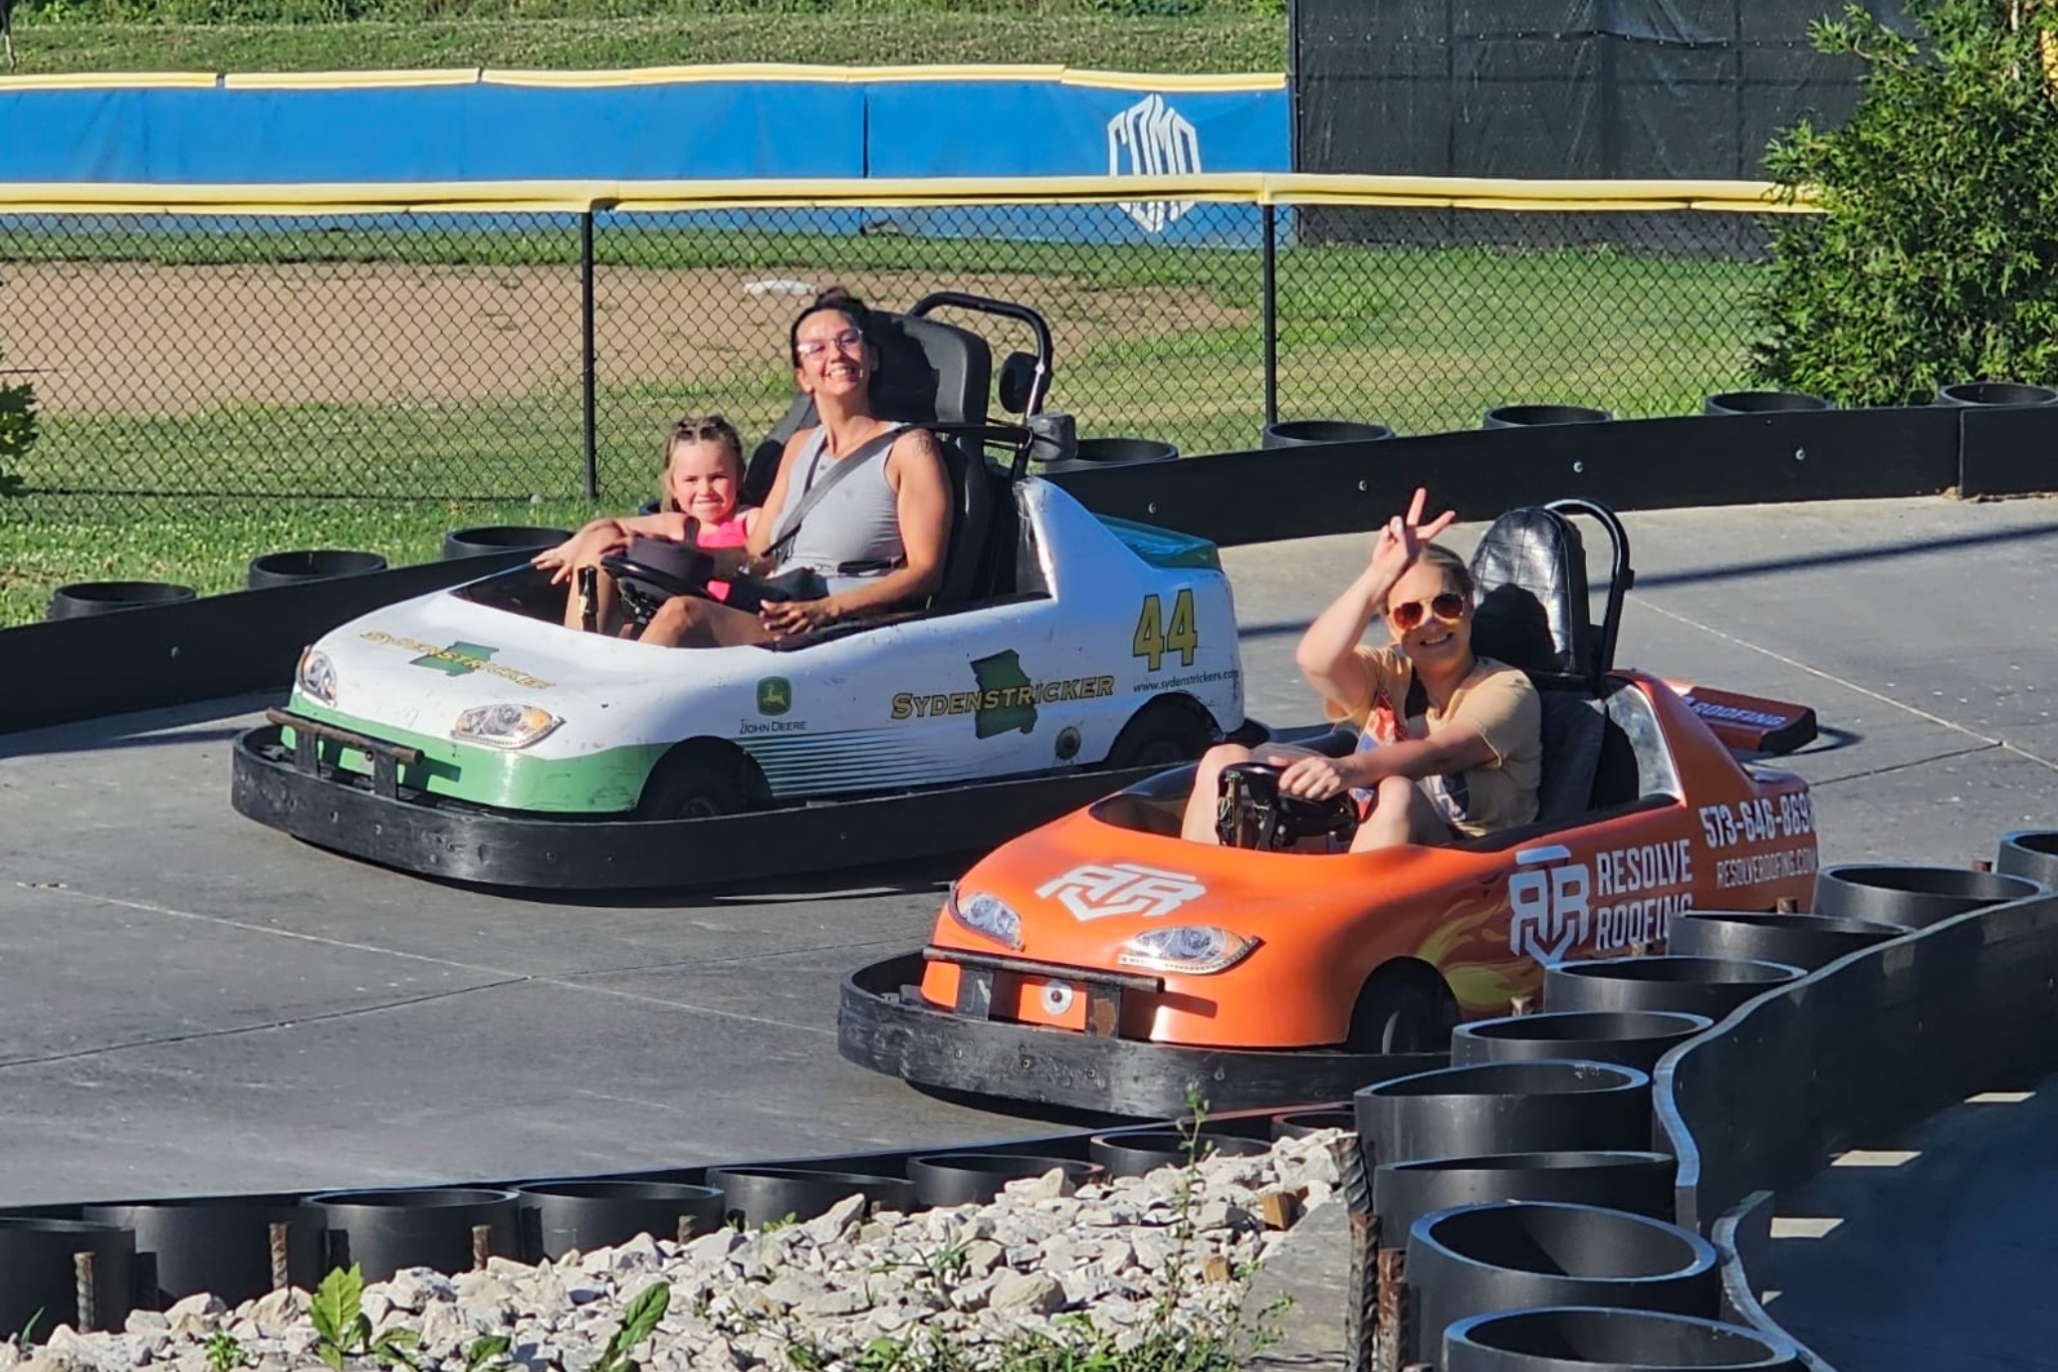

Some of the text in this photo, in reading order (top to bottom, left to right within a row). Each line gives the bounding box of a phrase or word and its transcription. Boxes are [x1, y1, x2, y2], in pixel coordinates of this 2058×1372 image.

[1132, 588, 1198, 672] 44
[891, 676, 1115, 719] SYDENSTRICKER
[740, 719, 807, 735] JOHN DEERE
[1596, 838, 1694, 897] RESOLVE
